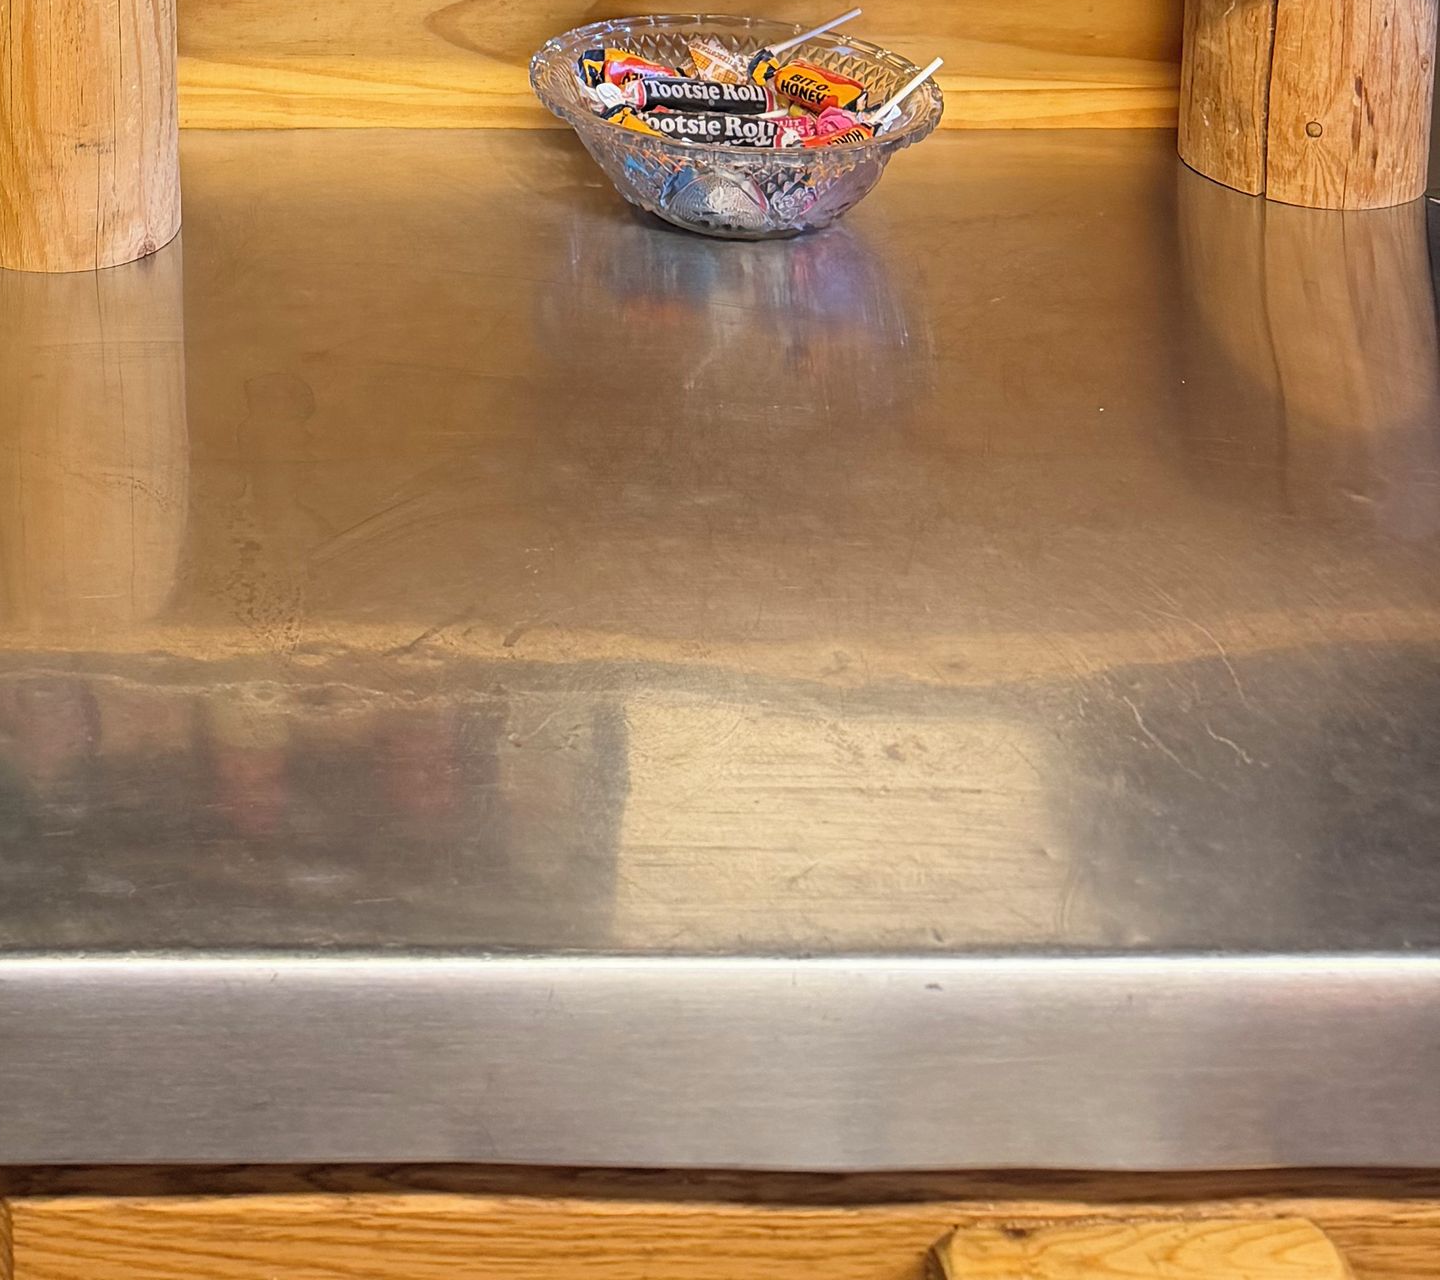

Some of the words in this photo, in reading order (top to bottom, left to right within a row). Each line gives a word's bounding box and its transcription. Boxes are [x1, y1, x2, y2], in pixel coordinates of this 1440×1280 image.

[647, 81, 720, 101] Tootsie
[719, 83, 766, 101] Roll
[781, 80, 826, 105] HONEY
[790, 74, 831, 93] BIT-O-
[725, 116, 776, 139] Roll
